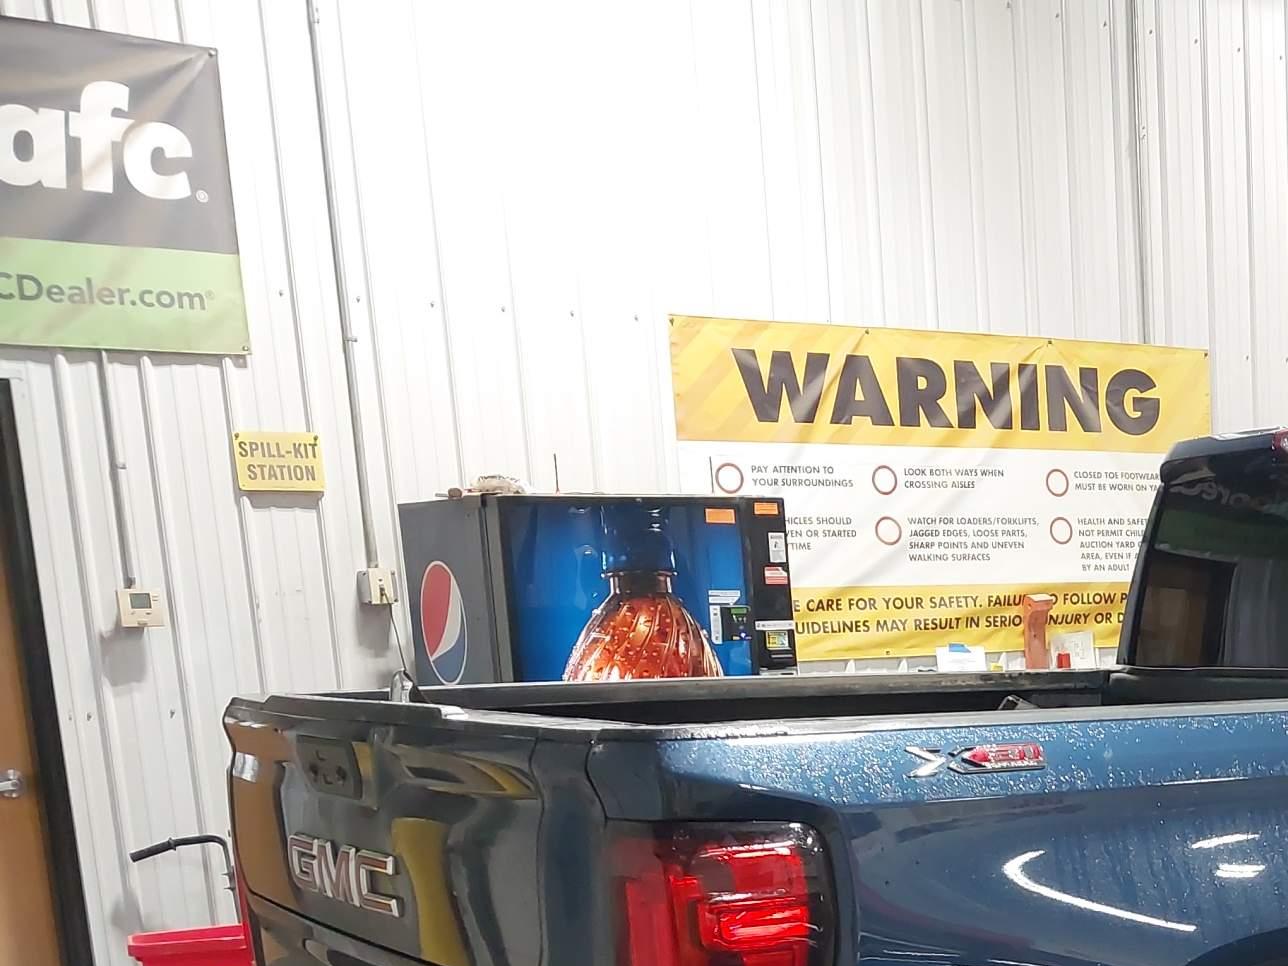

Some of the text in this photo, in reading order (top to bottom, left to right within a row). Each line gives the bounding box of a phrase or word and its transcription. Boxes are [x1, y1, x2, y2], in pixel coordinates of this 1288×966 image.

[731, 348, 1161, 436] WARNING
[238, 441, 318, 459] SPILL-KIT
[247, 463, 316, 481] STATION
[751, 465, 834, 475] PAY ATTENTION TO
[904, 467, 1004, 478] LOOK BOTH WAYS WHEN
[1074, 471, 1102, 480] CLOSED
[1104, 471, 1118, 480] TOE
[752, 478, 854, 488] YOUR SURROUNDINGS
[904, 480, 976, 489] CROSSING AISLES
[1075, 483, 1095, 491] MUST
[1098, 483, 1107, 491] BE
[1109, 483, 1133, 492] WORN
[1136, 484, 1147, 492] ON
[816, 516, 852, 525] SHOULD
[907, 517, 937, 526] WATCH
[938, 517, 954, 526] FOR
[1077, 517, 1106, 526] HEALTH
[1107, 517, 1125, 526] AND
[807, 529, 819, 538] OR
[822, 529, 857, 538] STARTED
[908, 529, 940, 538] JAGGED
[972, 529, 999, 538] LOOSE
[1078, 529, 1095, 538] NOT
[1097, 529, 1123, 538] PERMIT
[908, 541, 1025, 550] SHARP POINTS AND UNEVEN
[1079, 541, 1113, 550] AUCTION
[1116, 541, 1135, 549] YARD
[908, 553, 991, 562] WALKING SURFACES
[1105, 552, 1124, 561] EVEN
[1125, 552, 1132, 561] IF
[1081, 564, 1130, 572] BY AN ADULT
[806, 598, 843, 612] CARE
[848, 597, 878, 611] FOR
[882, 596, 924, 610] YOUR
[929, 595, 983, 609] SAFETY.
[1063, 592, 1116, 606] FOLLOW
[875, 618, 908, 633] MAY
[914, 617, 961, 631] RESULT
[965, 616, 980, 629] IN
[1094, 612, 1112, 625] OR
[287, 833, 400, 918] GMC
